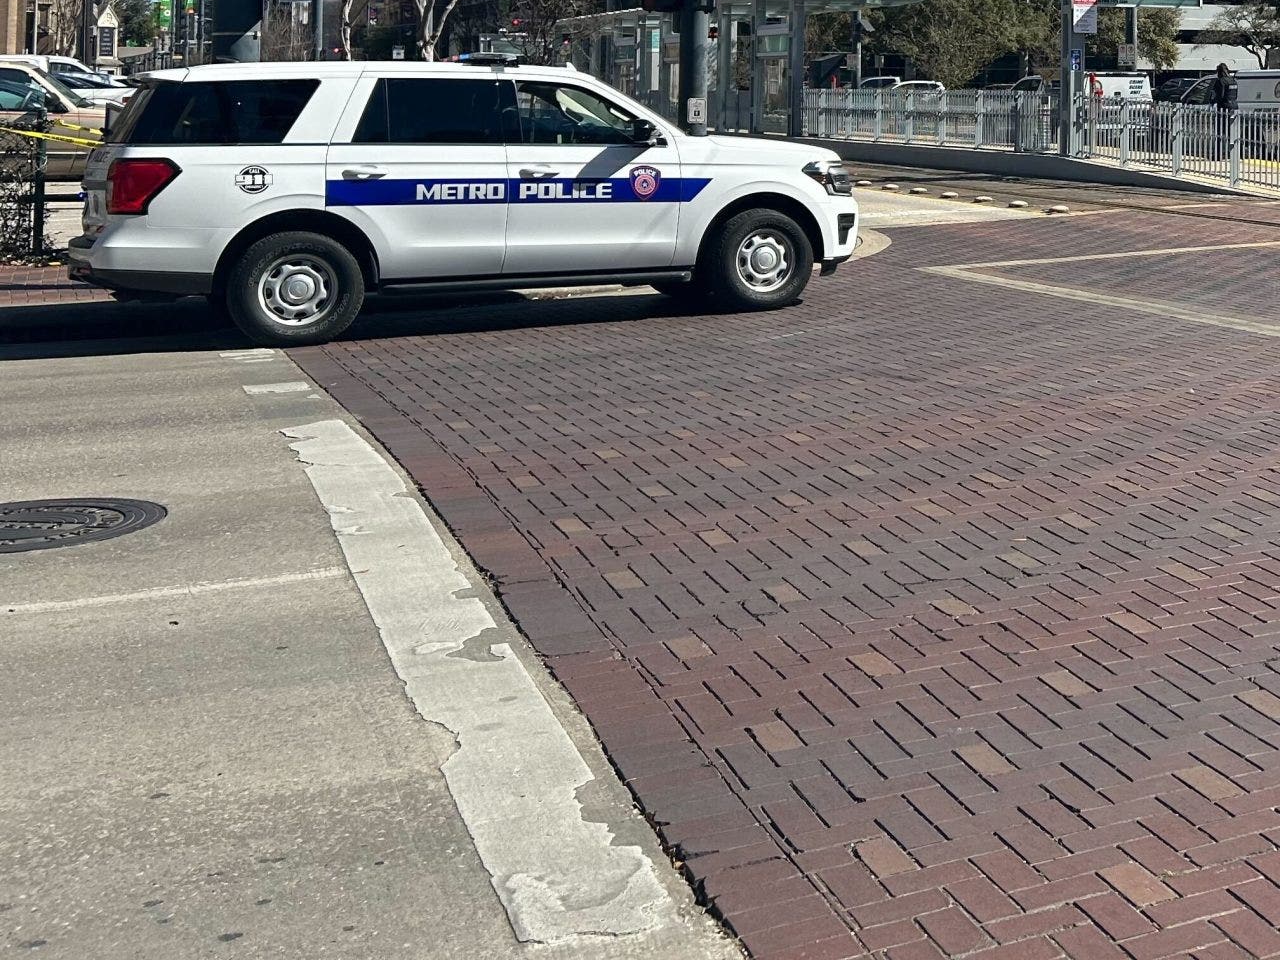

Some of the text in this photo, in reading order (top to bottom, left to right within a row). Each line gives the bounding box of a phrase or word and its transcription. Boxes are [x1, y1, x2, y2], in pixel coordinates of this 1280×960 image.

[633, 168, 657, 177] POLICE
[234, 173, 273, 186] 911
[415, 182, 612, 201] METRO POLICE
